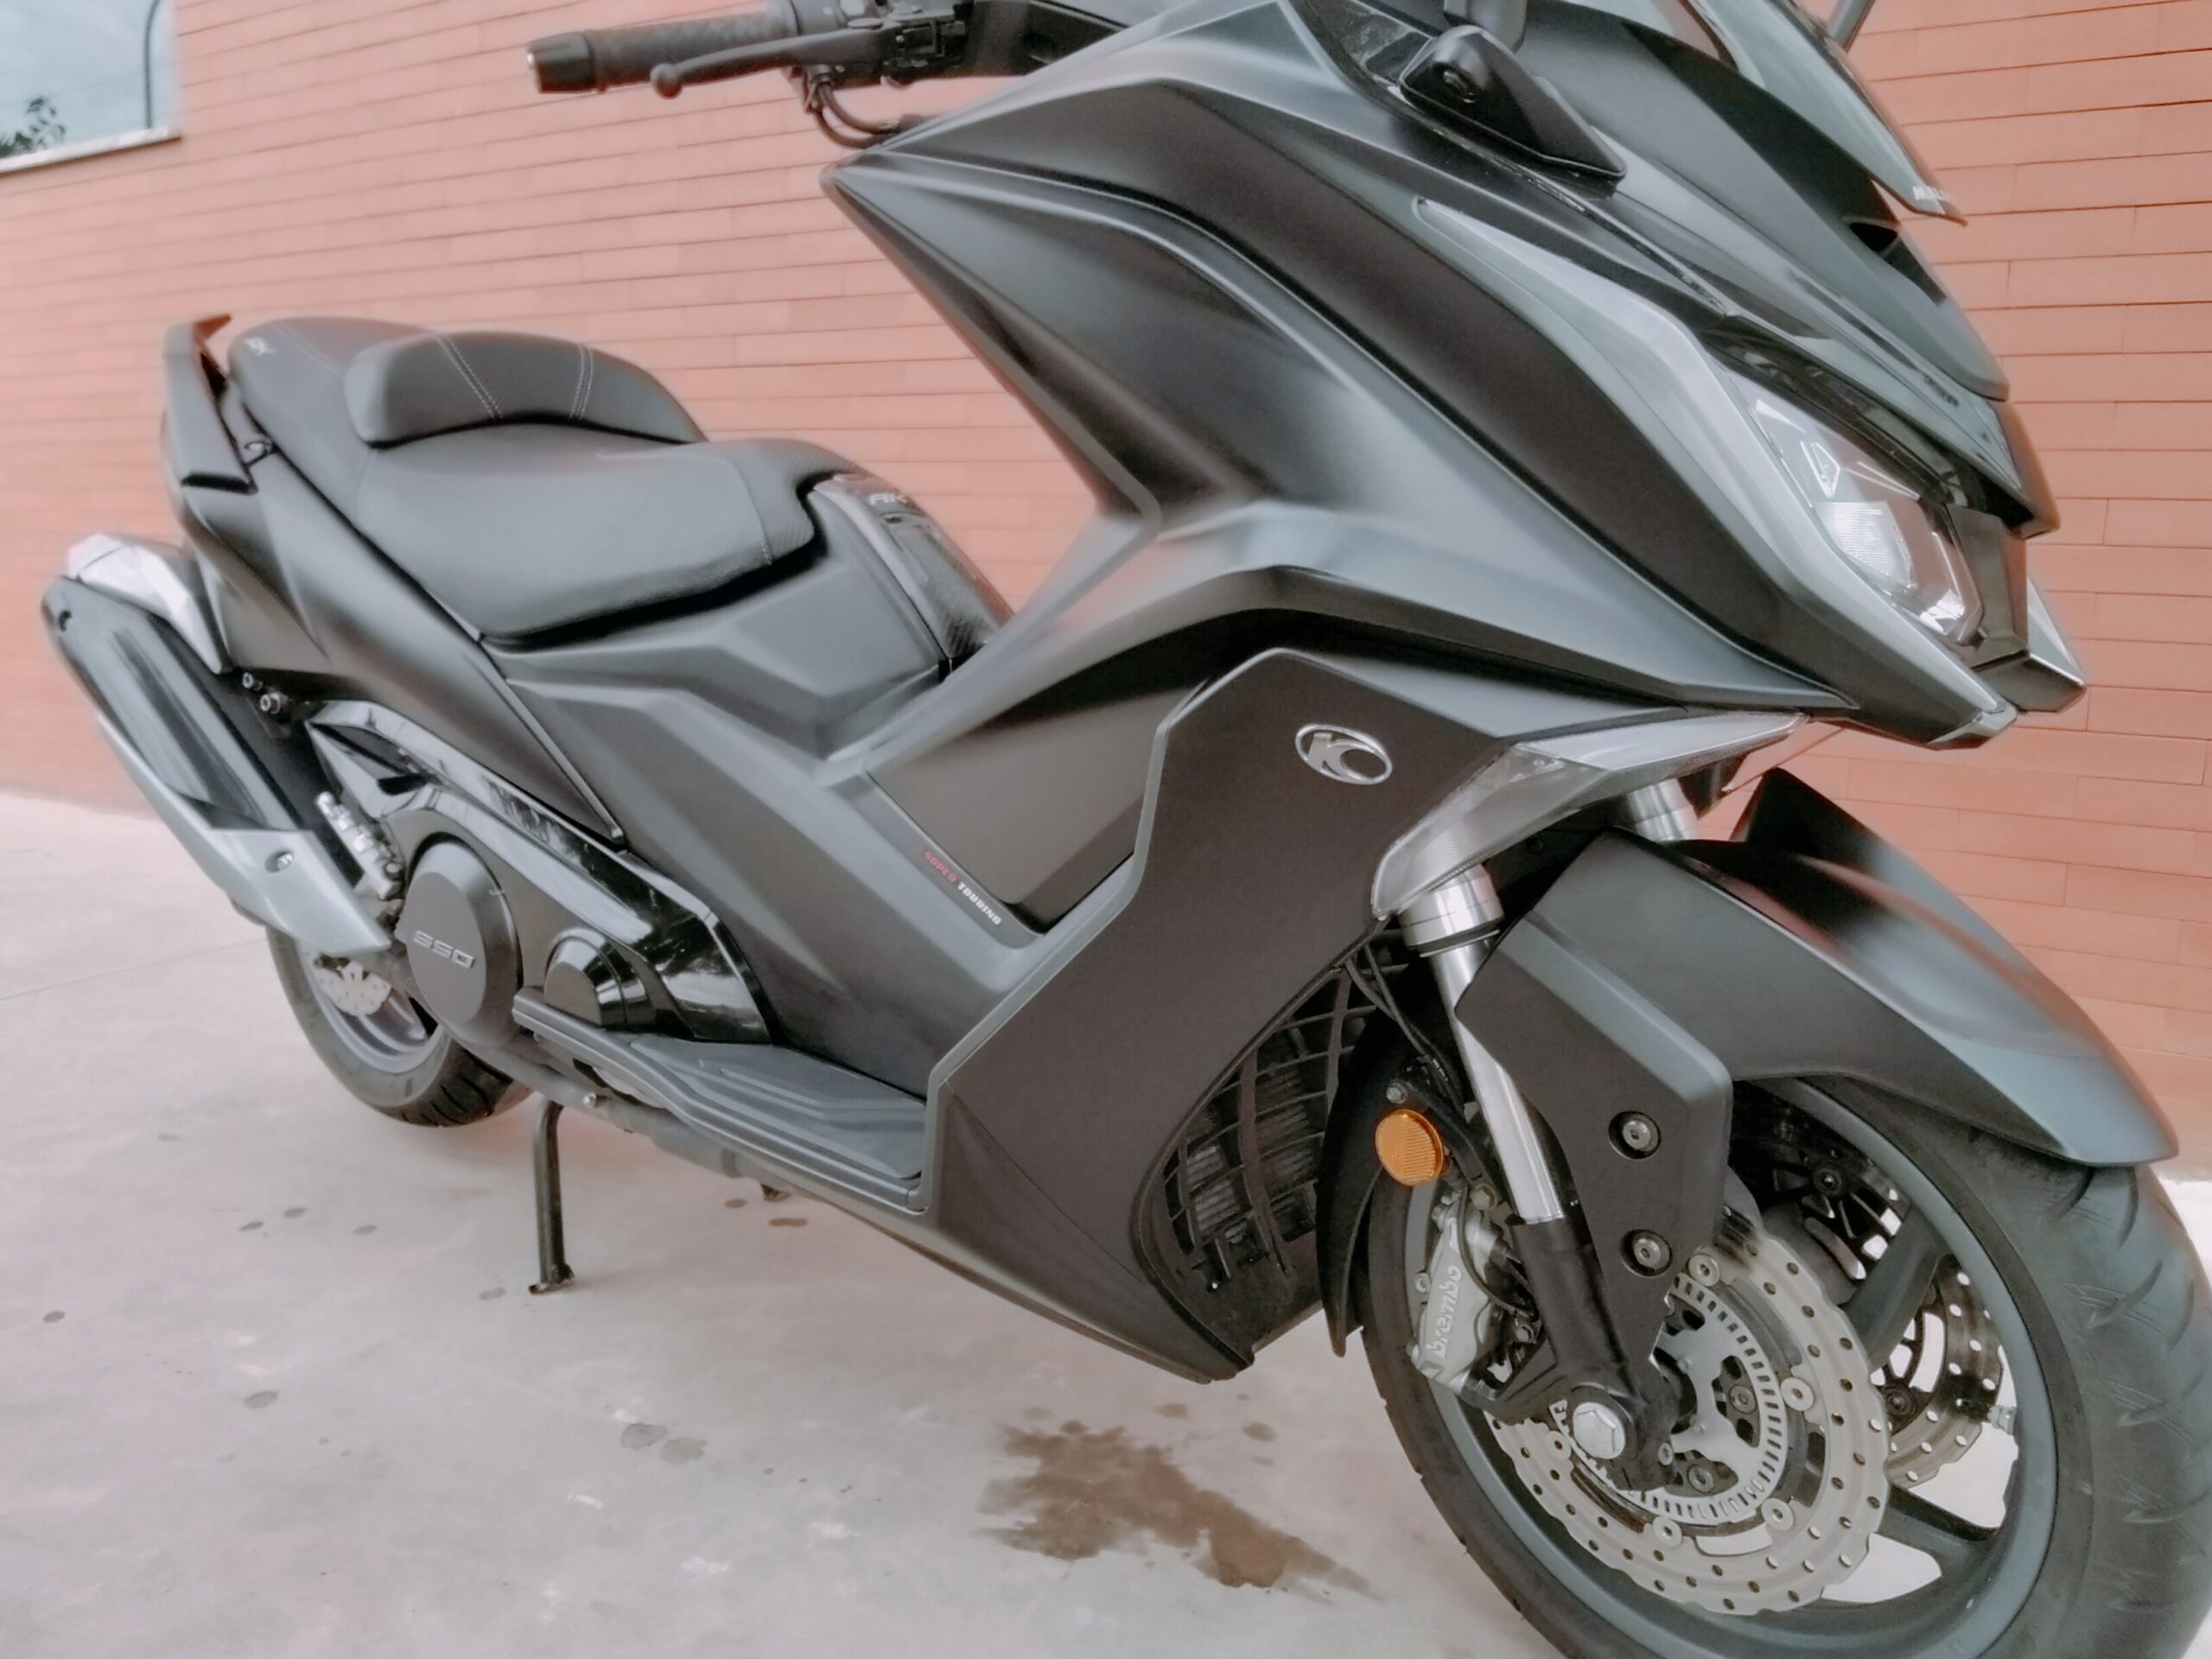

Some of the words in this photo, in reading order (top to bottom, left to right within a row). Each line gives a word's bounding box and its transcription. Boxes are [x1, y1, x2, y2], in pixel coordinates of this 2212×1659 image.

[957, 881, 1002, 925] TOURING
[414, 930, 475, 969] 550
[1427, 1264, 1462, 1359] brembo
